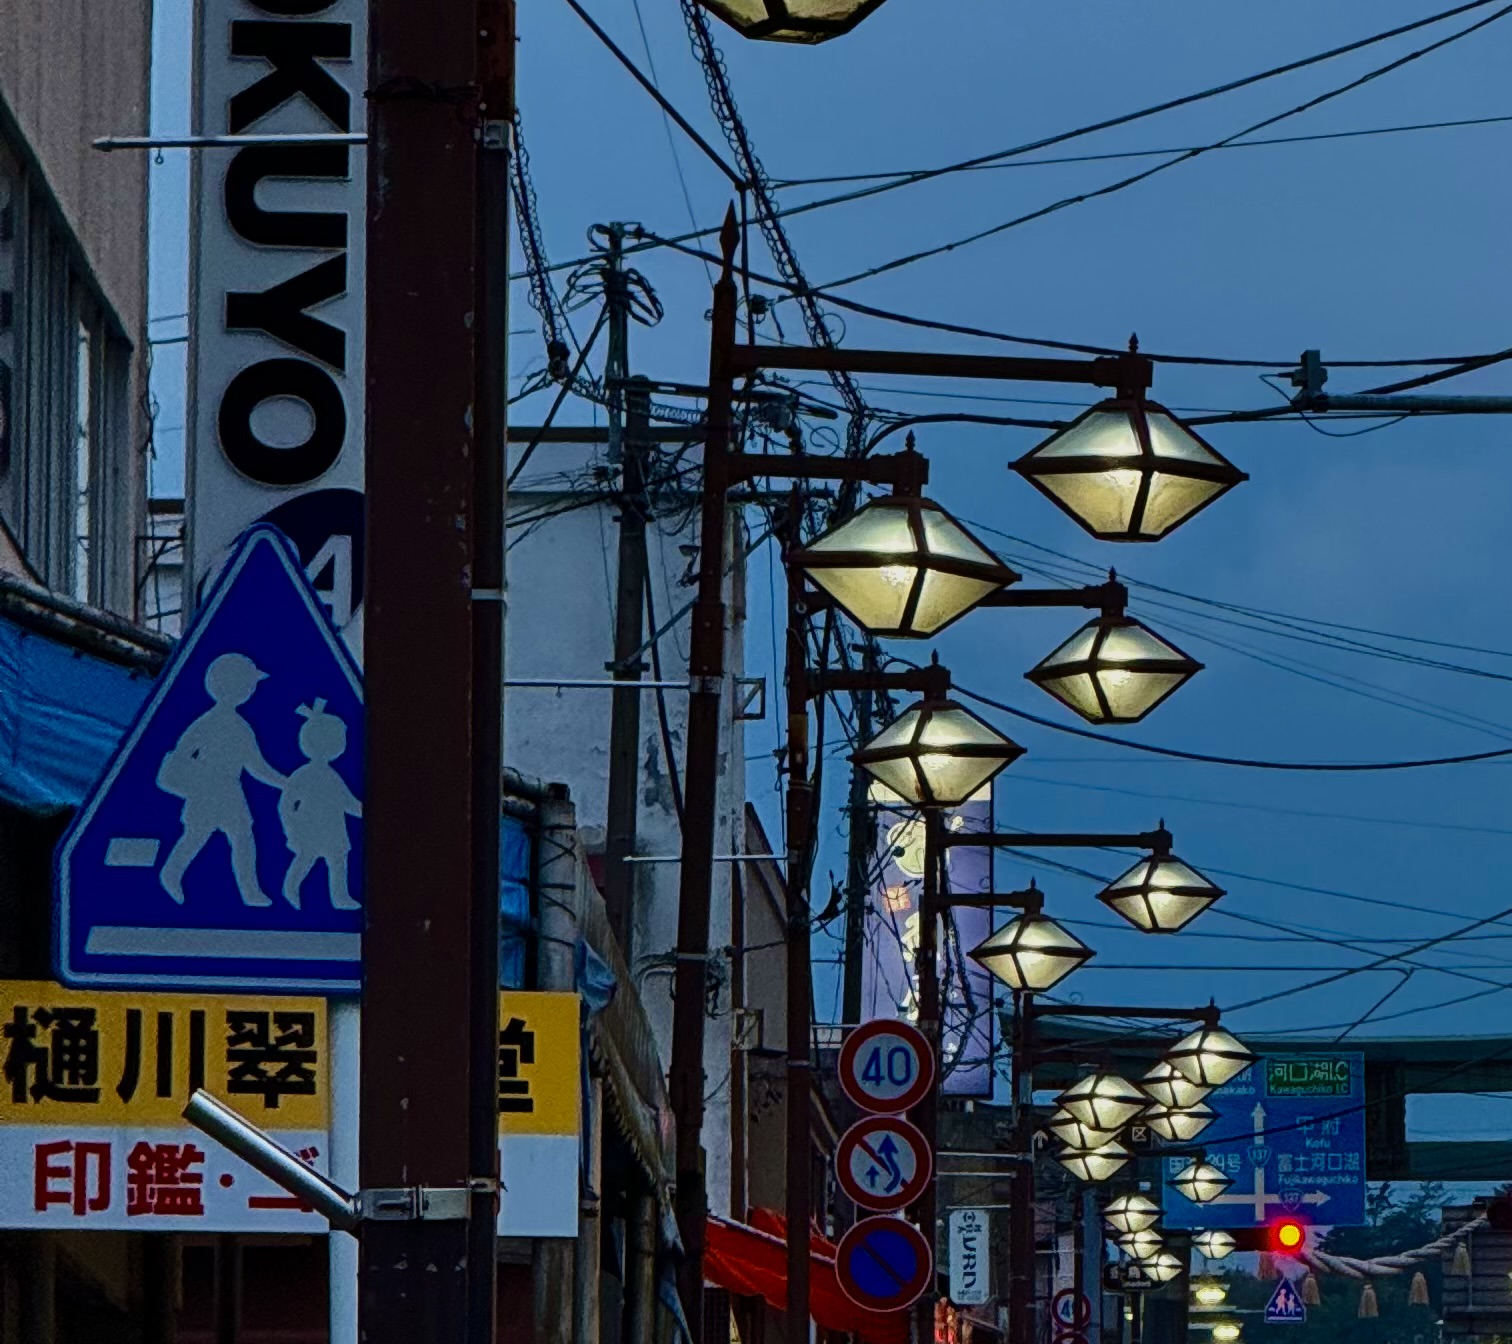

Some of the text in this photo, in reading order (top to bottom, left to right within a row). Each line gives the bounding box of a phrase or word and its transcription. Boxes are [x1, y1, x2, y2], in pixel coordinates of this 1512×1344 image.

[861, 1046, 912, 1088] 40
[1295, 1115, 1341, 1136] 甲府
[1252, 1147, 1268, 1159] 137
[1305, 1137, 1331, 1149] Kofu
[1277, 1152, 1360, 1173] 富士河口湖
